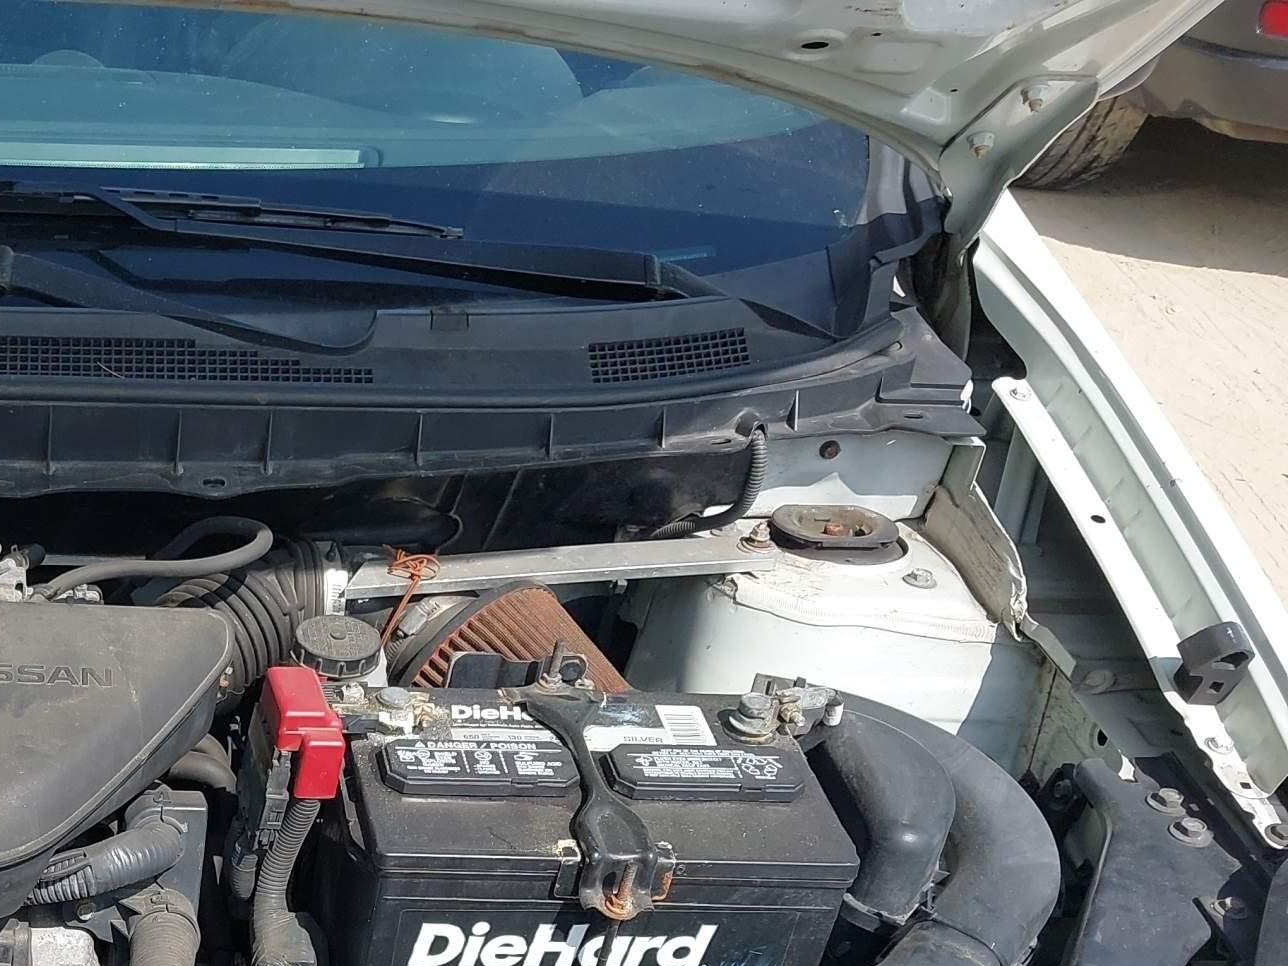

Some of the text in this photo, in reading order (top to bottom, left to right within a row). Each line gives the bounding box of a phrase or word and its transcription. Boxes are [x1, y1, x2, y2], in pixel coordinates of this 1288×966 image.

[623, 735, 663, 743] SILVER
[427, 741, 477, 750] DANGER
[490, 742, 536, 750] POISON
